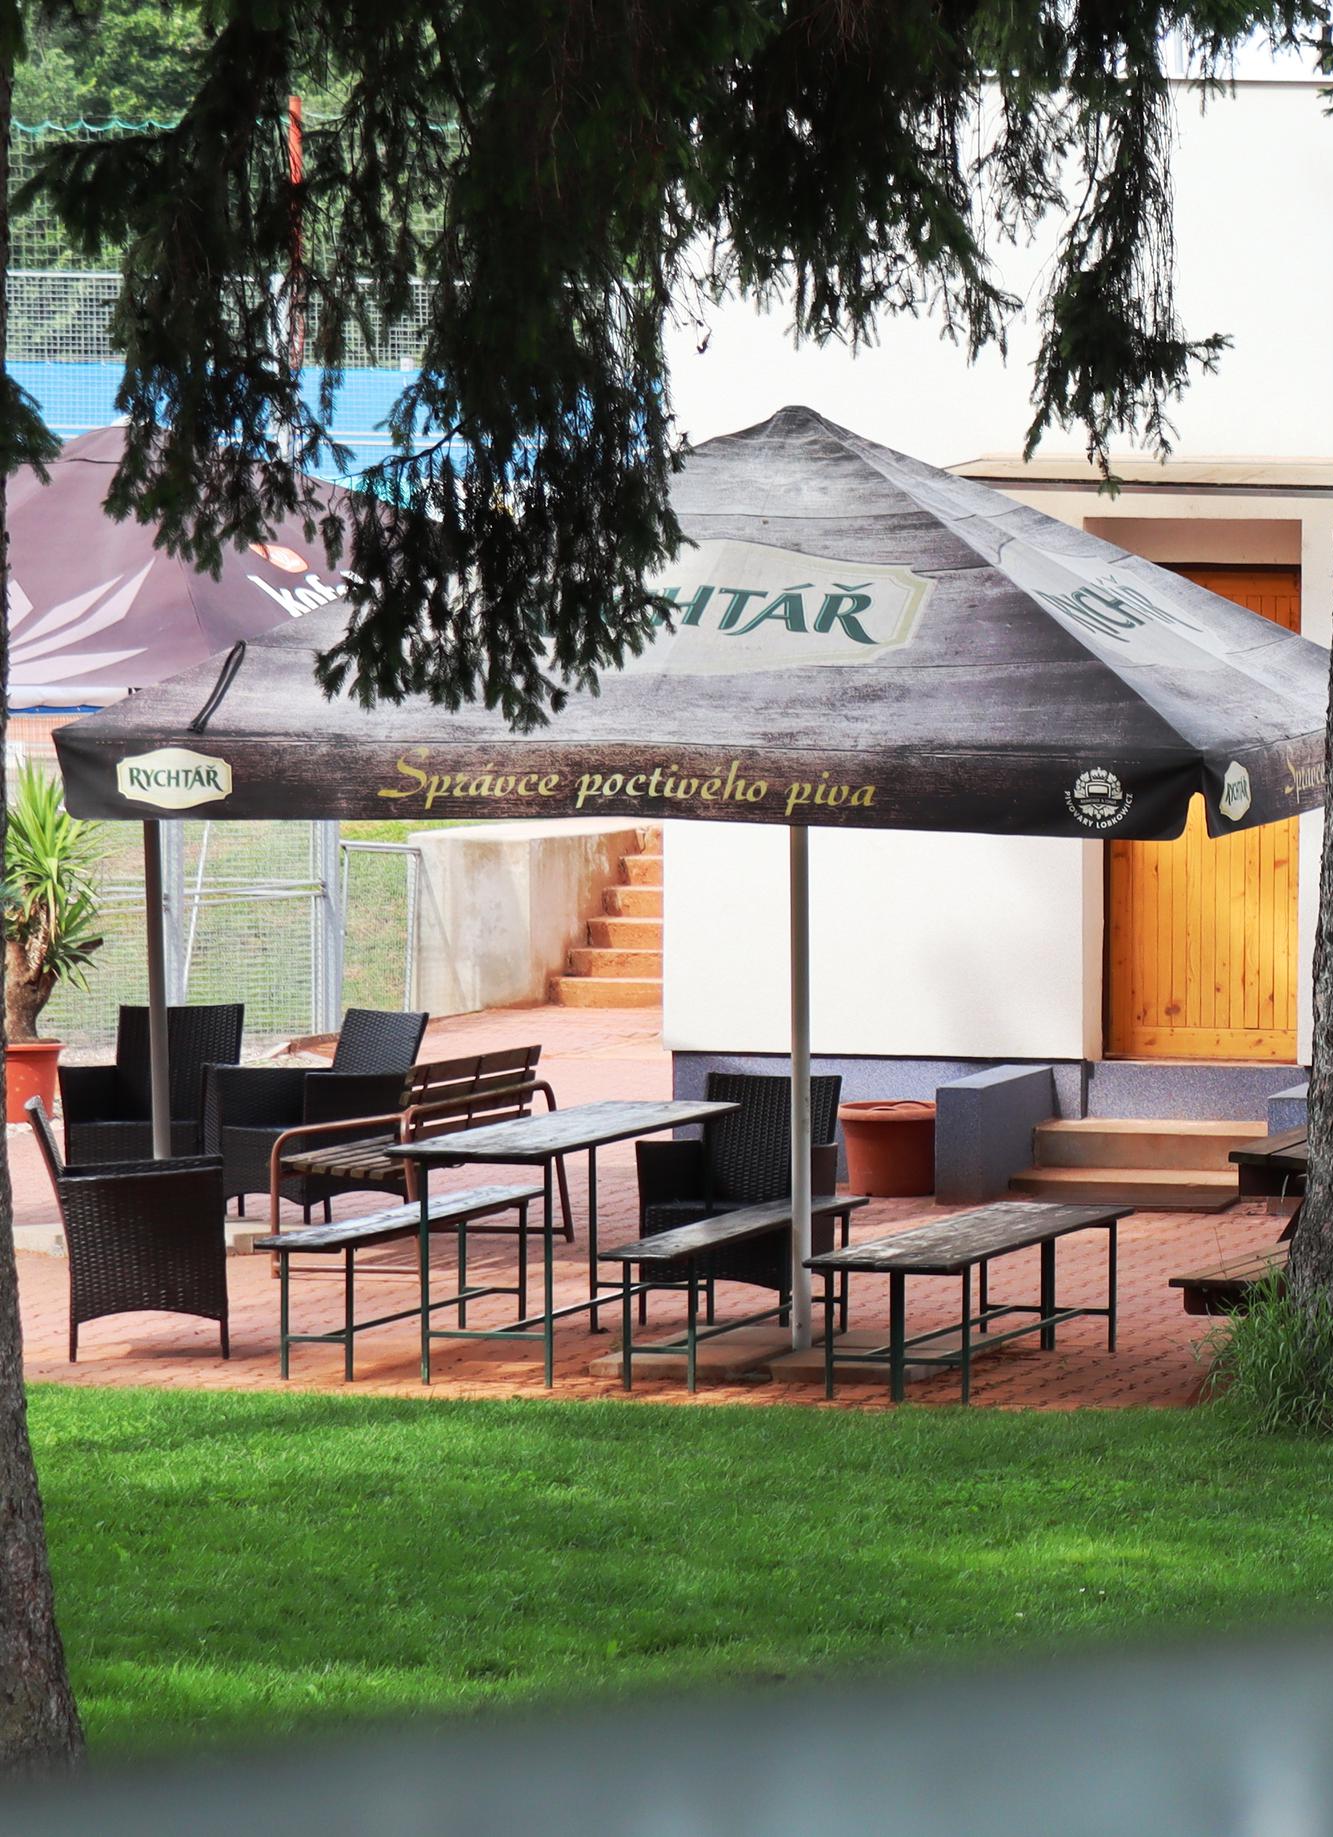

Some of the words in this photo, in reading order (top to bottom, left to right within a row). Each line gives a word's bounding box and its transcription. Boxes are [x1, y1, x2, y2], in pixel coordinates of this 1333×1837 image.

[128, 765, 224, 792] RYCHTÁŘ
[377, 746, 559, 808] Správce
[575, 760, 768, 809] poctivého
[785, 770, 876, 816] piva
[1064, 790, 1094, 827] PIVOVARY
[1096, 793, 1133, 829] LOBKOWICZ
